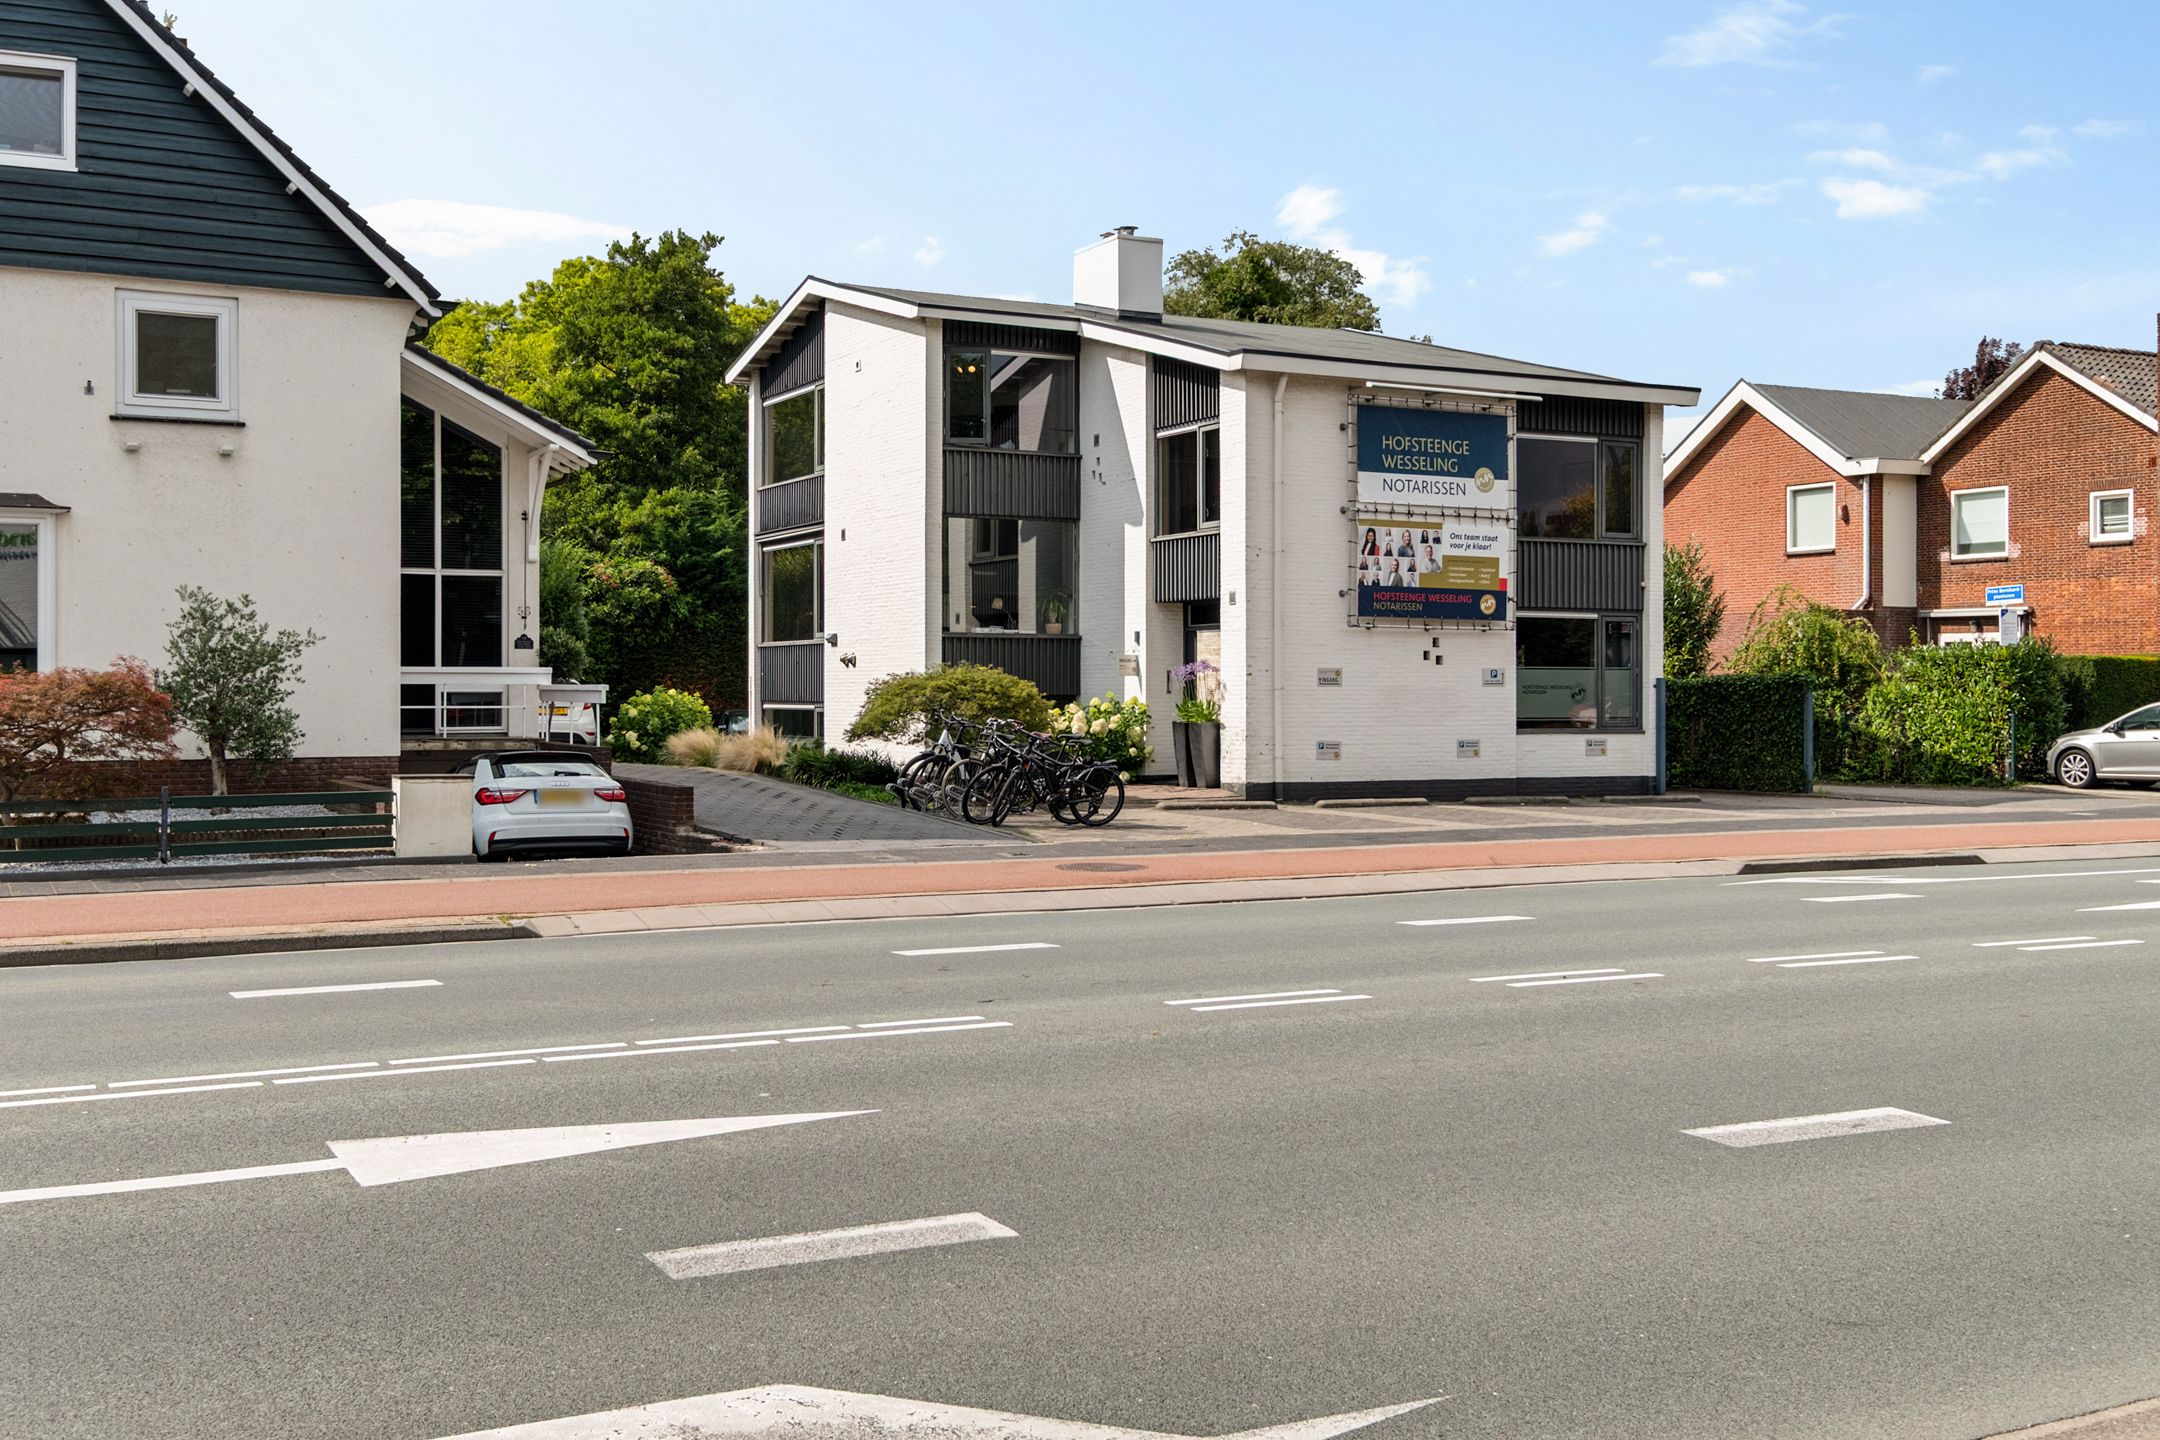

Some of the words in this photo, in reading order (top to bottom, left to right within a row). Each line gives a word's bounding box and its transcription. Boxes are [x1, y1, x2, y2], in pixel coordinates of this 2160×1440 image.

[1382, 435, 1470, 455] HOFSTEENGE
[1382, 454, 1458, 473] WESSELING
[1382, 478, 1466, 496] NOTARISSEN
[1449, 532, 1462, 540] Ons
[1464, 533, 1481, 541] team
[1464, 542, 1471, 551] je
[1373, 592, 1426, 602] HOFSTEENGE
[1428, 594, 1472, 604] WESSELING
[1373, 601, 1423, 611] NOTARISSEN
